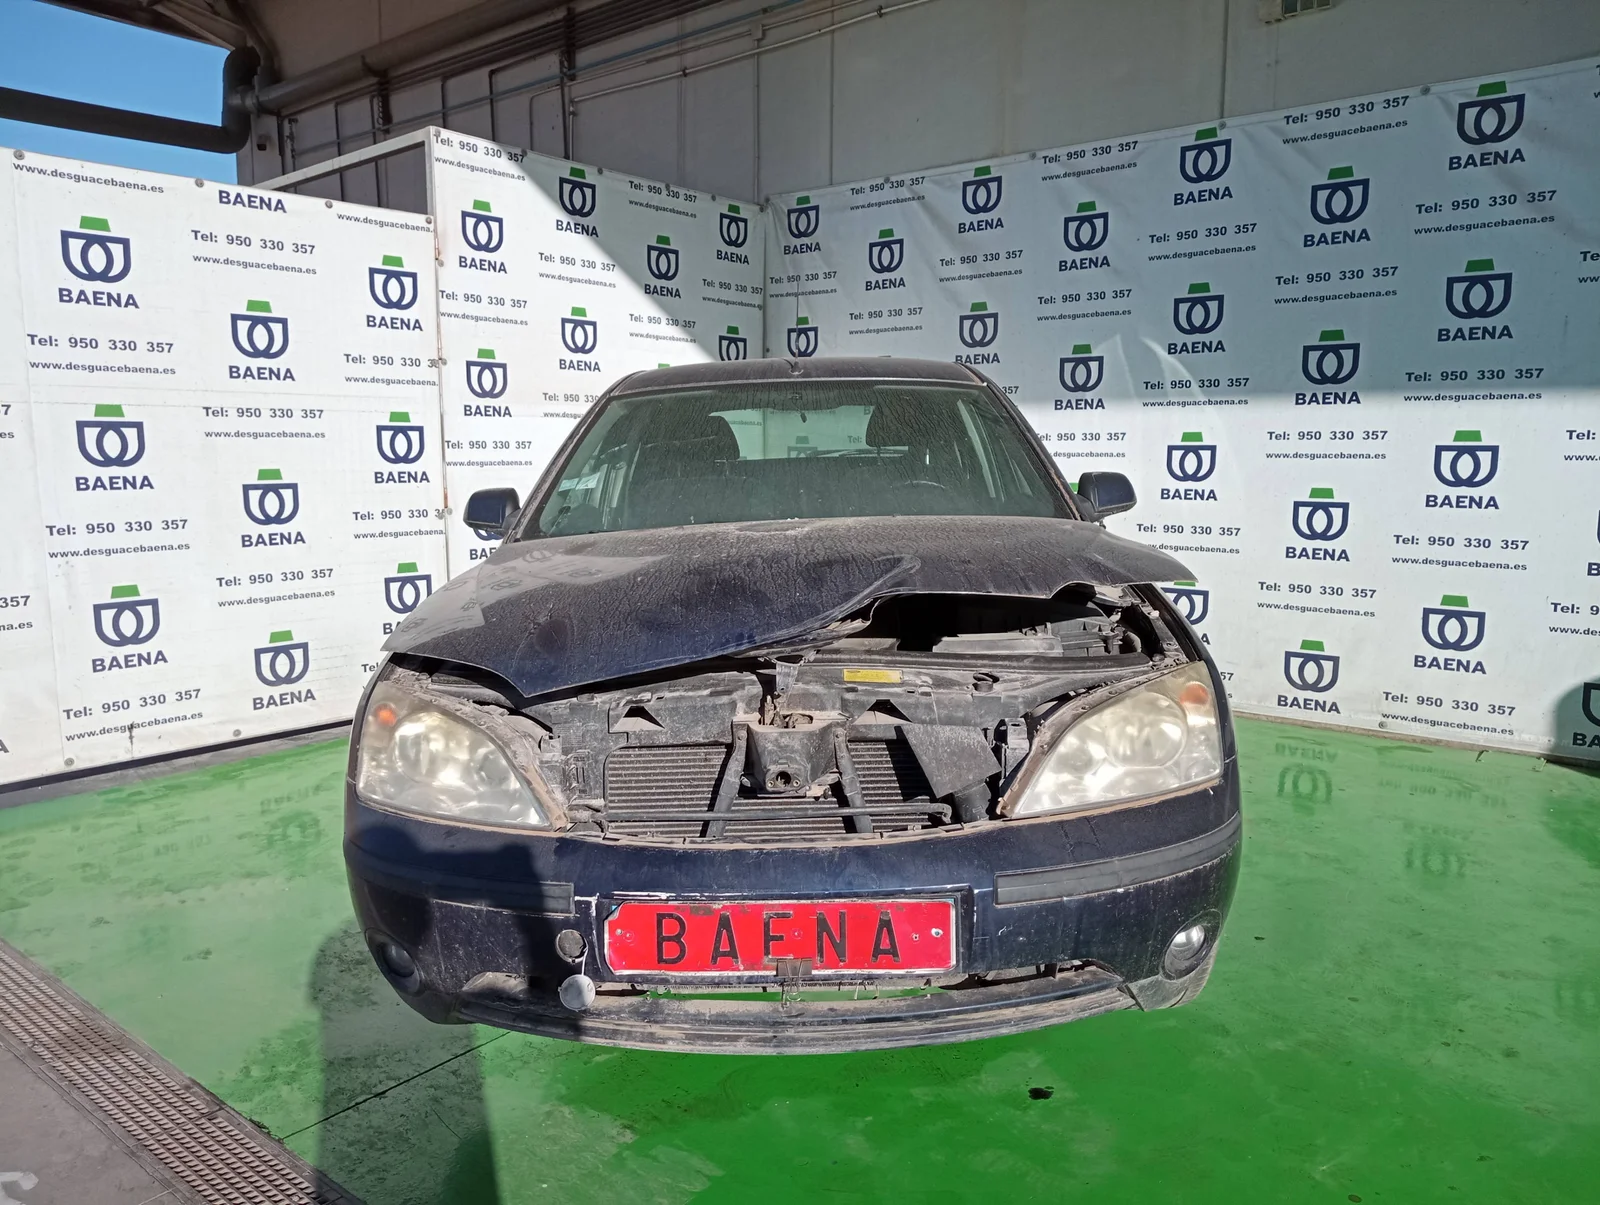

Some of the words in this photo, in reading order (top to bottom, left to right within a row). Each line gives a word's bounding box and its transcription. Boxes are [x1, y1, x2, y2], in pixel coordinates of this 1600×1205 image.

[1284, 113, 1308, 125] Tel:
[1315, 107, 1341, 120] 950
[1349, 102, 1375, 115] 330
[1383, 95, 1410, 109] 357
[1282, 120, 1408, 145] www.desguacebaena.es
[434, 134, 453, 147] Tel:
[459, 141, 478, 153] 950
[484, 147, 502, 158] 330
[508, 151, 525, 163] 357
[1449, 148, 1526, 171] BAENA
[13, 163, 164, 193] www.desguacebaena.es
[219, 190, 287, 214] BAENA
[1174, 186, 1233, 206] BAENA
[1416, 202, 1443, 214] Tel:
[1452, 198, 1480, 211] 950
[1489, 194, 1517, 207] 330
[1527, 190, 1557, 203] 357
[556, 220, 599, 238] BAENA
[958, 218, 1004, 234] BAENA
[1149, 233, 1170, 244] Tel:
[1177, 230, 1198, 241] 950
[1205, 226, 1227, 238] 330
[1234, 223, 1257, 234] 357
[1414, 216, 1555, 235] www.desguacebaena.es
[191, 230, 218, 243] Tel:
[226, 234, 252, 247] 950
[260, 239, 284, 251] 330
[292, 243, 315, 255] 357
[1304, 228, 1371, 248] BAENA
[784, 242, 822, 255] BAENA
[1148, 245, 1256, 261] www.desguacebaena.es
[459, 256, 508, 274] BAENA
[538, 252, 555, 263] Tel:
[560, 256, 576, 266] 950
[581, 259, 596, 269] 330
[601, 263, 616, 272] 357
[717, 249, 750, 265] BAENA
[940, 258, 955, 267] Tel:
[960, 255, 977, 264] 950
[983, 252, 1000, 262] 330
[1006, 250, 1023, 260] 357
[1059, 256, 1111, 272] BAENA
[193, 256, 317, 275] www.desguacebaena.es
[787, 275, 801, 283] 950
[805, 273, 819, 282] 330
[823, 271, 837, 280] 357
[865, 277, 906, 291] BAENA
[939, 269, 1023, 283] www.desguacebaena.es
[1275, 275, 1299, 286] Tel:
[1307, 272, 1331, 283] 950
[1339, 269, 1364, 281] 330
[1372, 266, 1399, 278] 357
[58, 288, 140, 309] BAENA
[644, 283, 681, 299] BAENA
[1038, 296, 1056, 305] Tel:
[1062, 293, 1081, 303] 950
[1087, 291, 1106, 301] 330
[1112, 289, 1132, 299] 357
[1274, 290, 1397, 304] www.desguacebaena.es
[440, 290, 458, 301] Tel:
[464, 293, 482, 304] 950
[488, 296, 505, 306] 330
[511, 299, 527, 309] 357
[440, 311, 528, 326] www.desguacebaena.es
[849, 312, 864, 320] Tel:
[868, 310, 883, 319] 950
[888, 309, 903, 317] 330
[908, 307, 923, 316] 357
[1037, 310, 1132, 321] www.desguacebaena.es
[366, 315, 423, 332] BAENA
[1438, 325, 1514, 342] BAENA
[27, 334, 59, 347] Tel:
[68, 337, 99, 349] 950
[108, 339, 137, 351] 330
[147, 342, 174, 353] 357
[1168, 340, 1226, 355] BAENA
[559, 359, 601, 372] BAENA
[956, 353, 1000, 365] BAENA
[29, 362, 176, 375] www.desguacebaena.es
[229, 365, 296, 382] BAENA
[1405, 372, 1432, 382] Tel:
[1441, 371, 1468, 381] 950
[1477, 369, 1505, 380] 330
[1515, 368, 1544, 379] 357
[1143, 381, 1164, 390] Tel:
[1171, 380, 1192, 389] 950
[1198, 379, 1220, 389] 330
[1227, 378, 1250, 388] 357
[1055, 398, 1105, 411] BAENA
[1142, 399, 1248, 408] www.desguacebaena.es
[1295, 391, 1361, 405] BAENA
[1404, 392, 1542, 403] www.desguacebaena.es
[202, 407, 228, 417] Tel:
[237, 408, 262, 418] 950
[270, 408, 293, 418] 330
[301, 409, 324, 419] 357
[464, 405, 512, 418] BAENA
[204, 430, 326, 440] www.desguacebaena.es
[1267, 431, 1290, 441] Tel:
[1298, 431, 1322, 440] 950
[1330, 431, 1354, 440] 330
[1362, 431, 1388, 440] 357
[1566, 430, 1596, 440] Tel:
[445, 440, 463, 450] Tel:
[469, 441, 487, 449] 950
[493, 441, 510, 449] 330
[516, 441, 532, 449] 357
[1266, 452, 1386, 461] www.desguacebaena.es
[75, 476, 155, 491] BAENA
[374, 471, 430, 484] BAENA
[1161, 488, 1218, 501] BAENA
[1425, 495, 1500, 510] BAENA
[45, 525, 76, 536] Tel:
[86, 523, 115, 534] 950
[125, 521, 152, 532] 330
[162, 519, 188, 530] 357
[241, 531, 306, 548] BAENA
[1393, 535, 1419, 545] Tel:
[1428, 536, 1455, 547] 950
[1464, 538, 1491, 549] 330
[1501, 540, 1529, 550] 357
[48, 544, 190, 558] www.desguacebaena.es
[1286, 546, 1350, 562] BAENA
[1392, 557, 1527, 571] www.desguacebaena.es
[216, 576, 241, 587] Tel:
[249, 573, 273, 584] 950
[281, 571, 304, 582] 330
[311, 568, 333, 579] 357
[1258, 582, 1281, 592] Tel:
[1289, 584, 1312, 594] 950
[1320, 586, 1344, 596] 330
[1352, 588, 1377, 599] 357
[218, 591, 335, 607] www.desguacebaena.es
[1257, 603, 1375, 617] www.desguacebaena.es
[1551, 602, 1580, 614] Tel:
[92, 650, 168, 673] BAENA
[1414, 655, 1487, 675] BAENA
[253, 689, 316, 711] BAENA
[1278, 695, 1341, 714] BAENA
[1383, 692, 1408, 703] Tel:
[1417, 696, 1443, 707] 950
[1452, 700, 1479, 712] 330
[1488, 704, 1516, 716] 357
[1382, 713, 1514, 736] www.desguacebaena.es
[655, 911, 900, 964] BAENA
